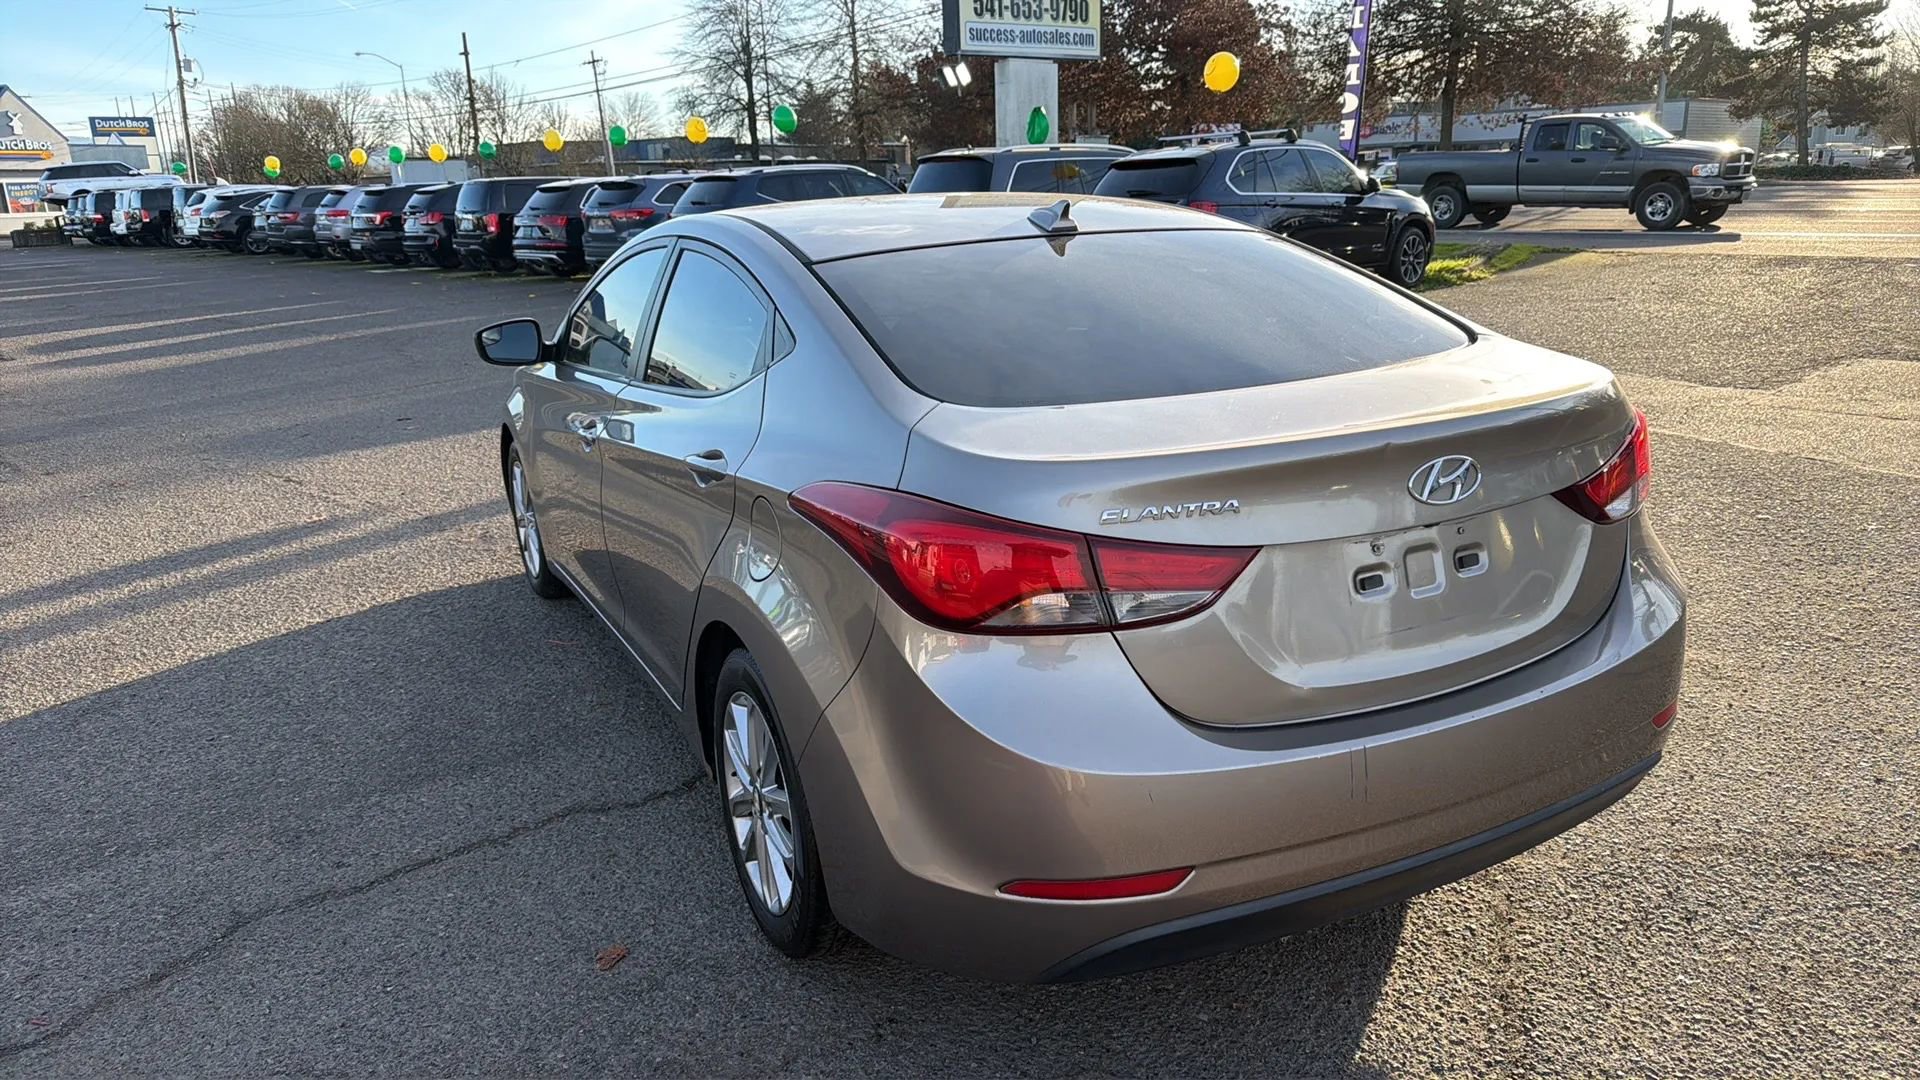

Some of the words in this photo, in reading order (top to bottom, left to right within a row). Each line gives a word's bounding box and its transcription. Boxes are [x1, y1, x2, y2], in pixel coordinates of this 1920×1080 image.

[973, 0, 1089, 23] 541-653-9790
[968, 26, 1095, 47] success-autosales.com
[1099, 499, 1240, 526] ELANTRA
